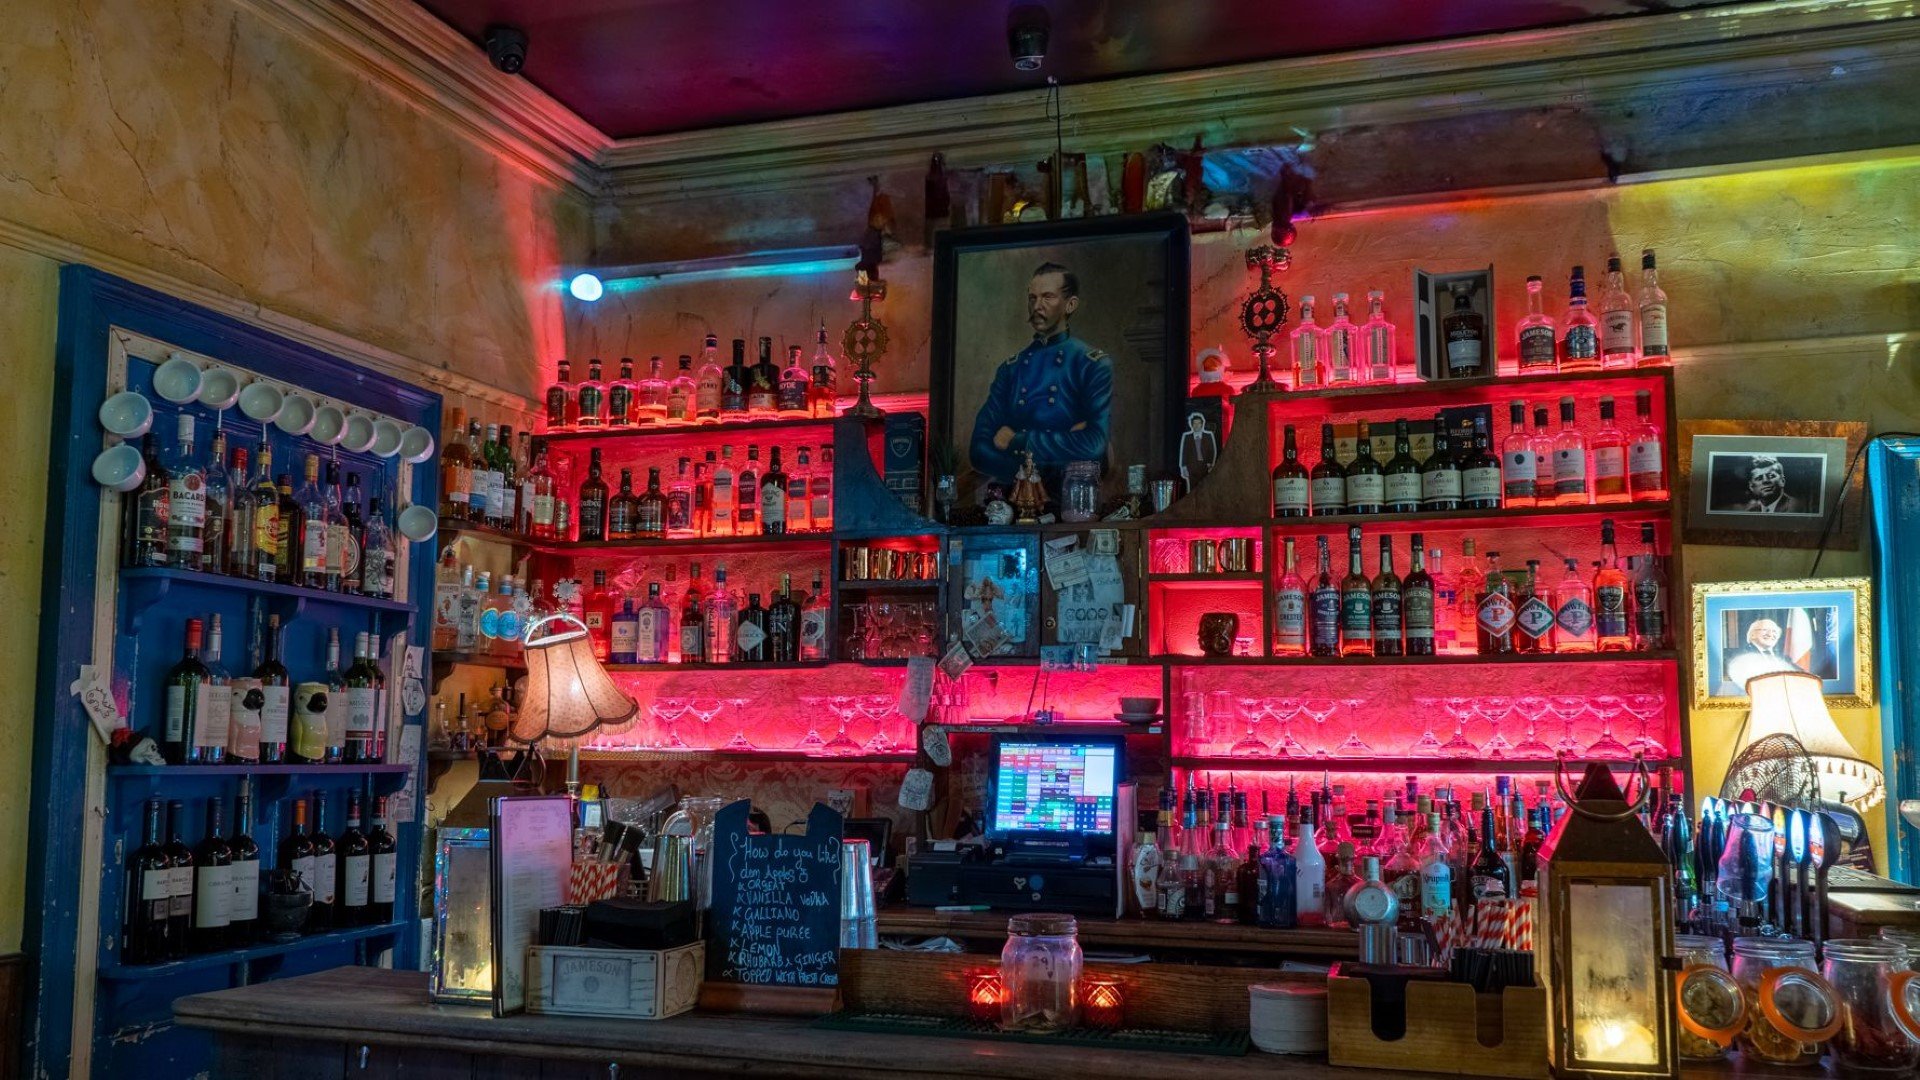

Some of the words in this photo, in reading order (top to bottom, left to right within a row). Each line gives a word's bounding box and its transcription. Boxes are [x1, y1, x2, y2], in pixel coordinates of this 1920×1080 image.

[1521, 329, 1554, 340] JAMESON
[173, 491, 206, 500] BACARD
[589, 617, 600, 626] 24
[1530, 611, 1544, 625] P
[740, 837, 769, 862] How
[774, 838, 793, 858] do
[793, 848, 813, 870] you
[746, 891, 793, 906] VANILLA
[741, 923, 772, 941] APPLE
[742, 940, 780, 958] LEMON
[562, 960, 621, 977] JAMESON
[794, 950, 837, 972] GINGER
